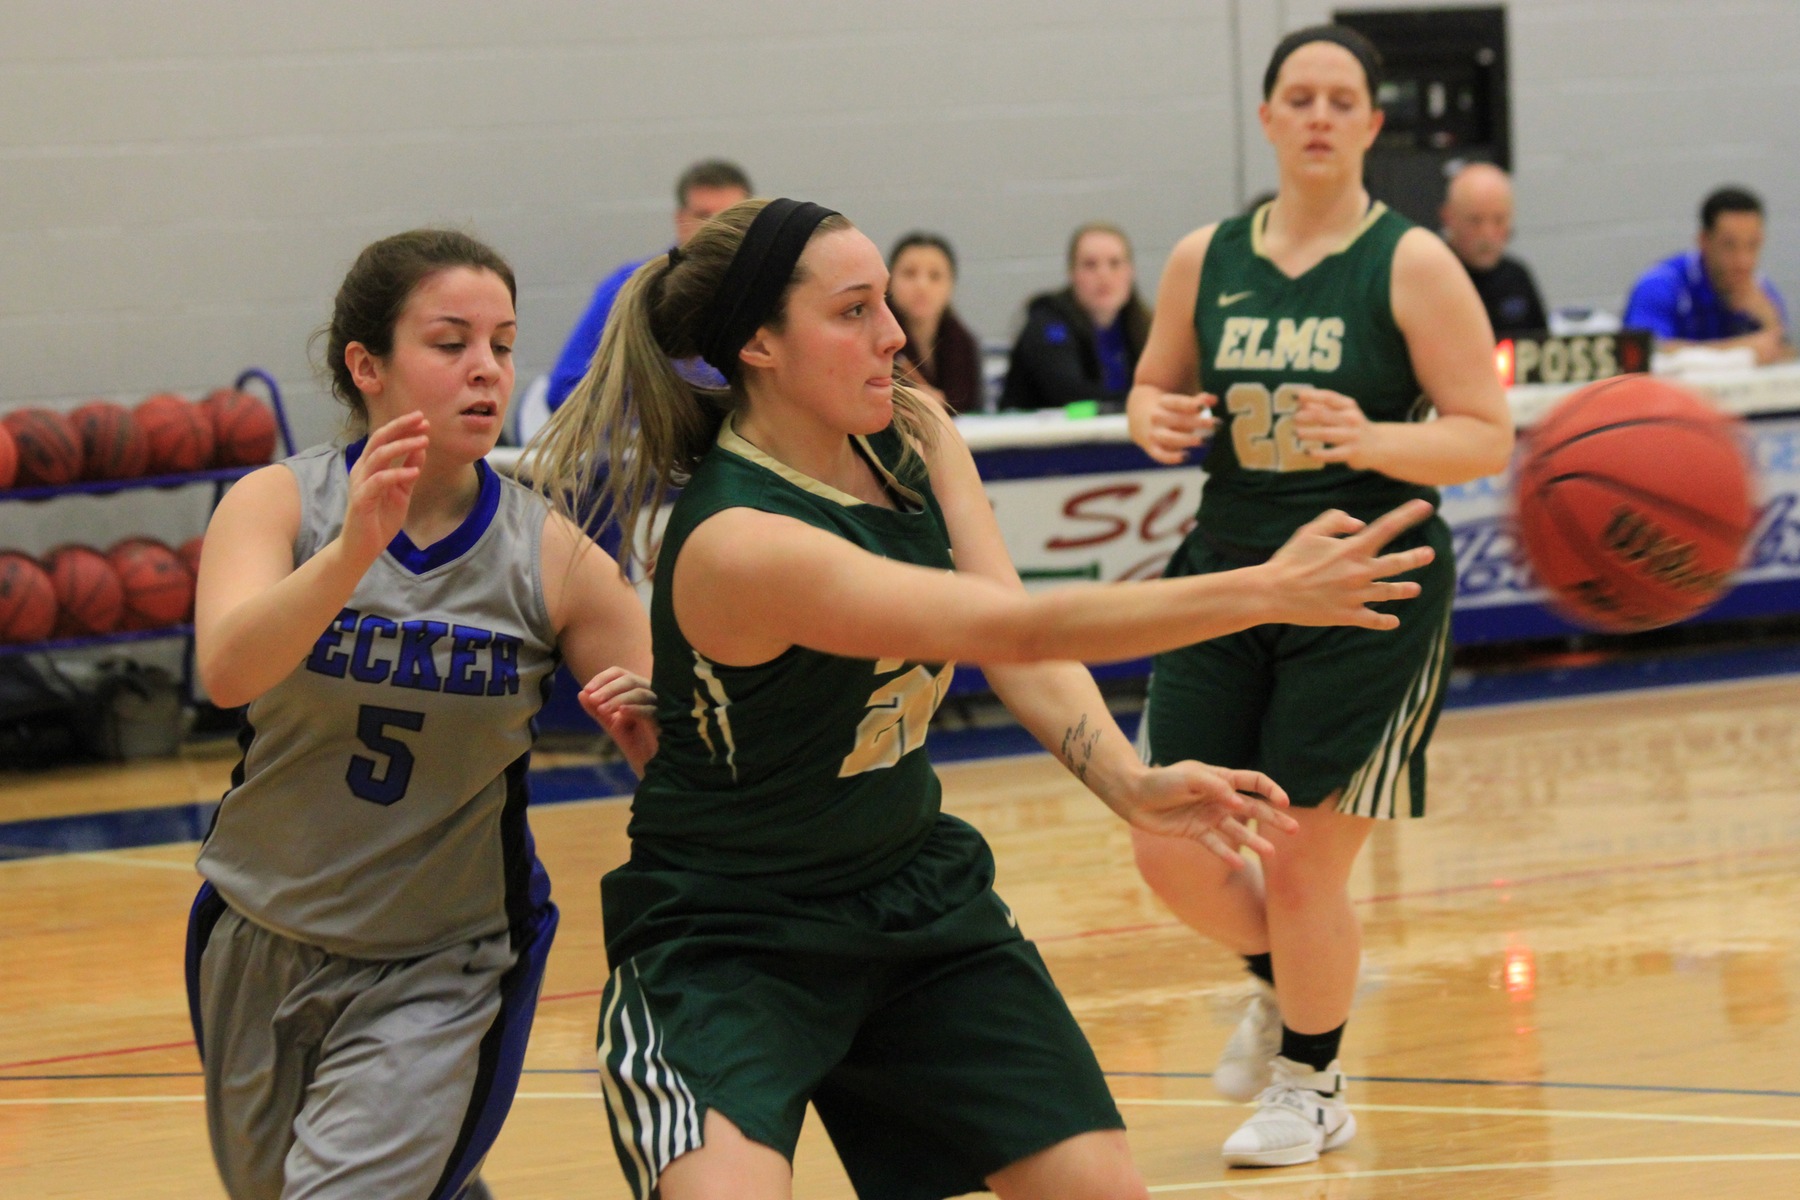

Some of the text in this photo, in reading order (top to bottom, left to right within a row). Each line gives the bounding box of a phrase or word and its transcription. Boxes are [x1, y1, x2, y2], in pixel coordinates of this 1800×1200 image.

[1214, 316, 1345, 373] ELMS
[1514, 336, 1616, 384] POSS
[1044, 480, 1198, 550] Sl
[345, 703, 426, 807] 5
